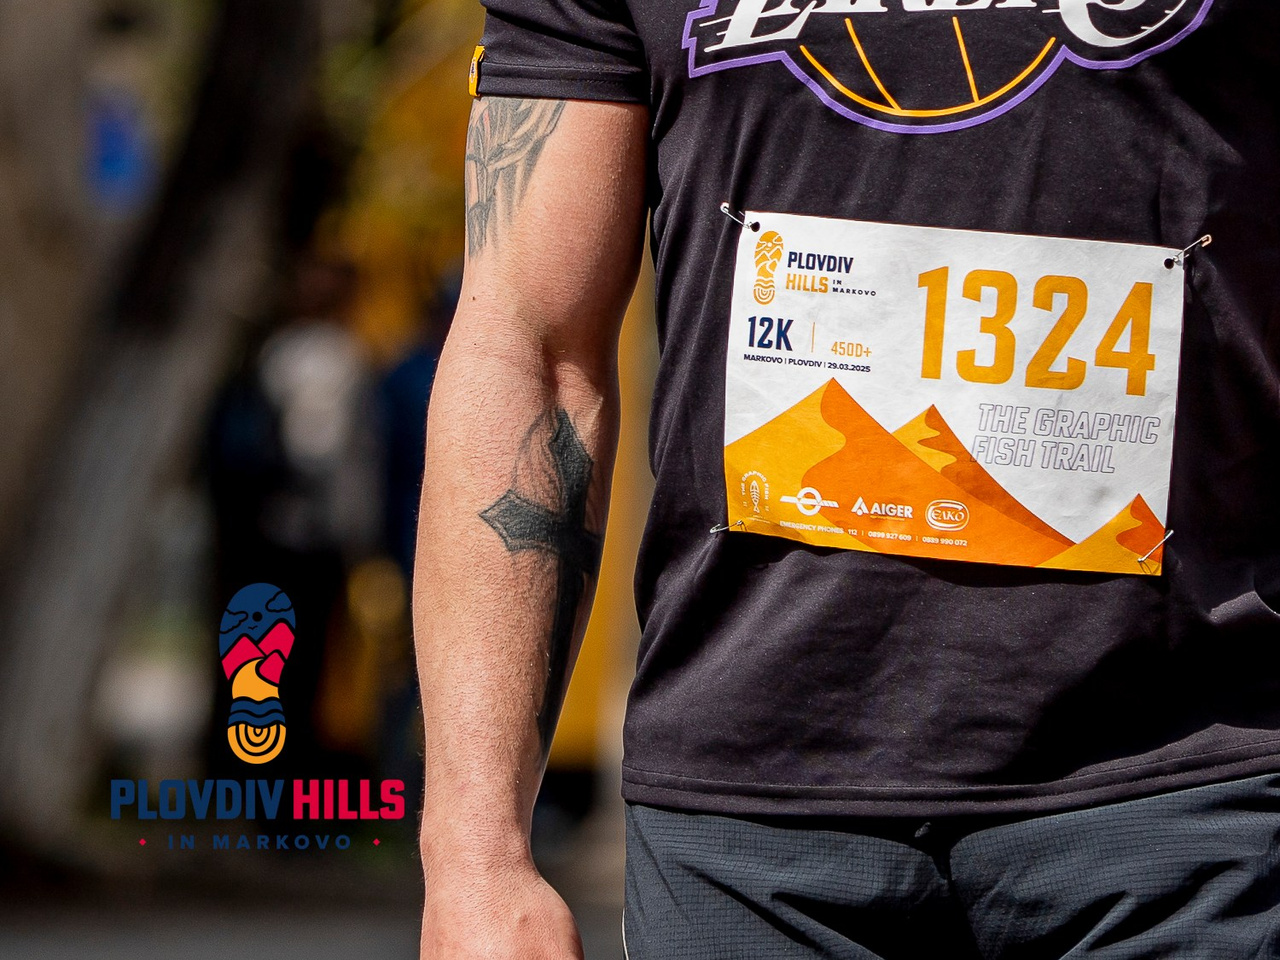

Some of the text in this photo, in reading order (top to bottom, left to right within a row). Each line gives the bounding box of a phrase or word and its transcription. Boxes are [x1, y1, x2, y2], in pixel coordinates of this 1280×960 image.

[787, 251, 854, 273] PLOVDIV
[785, 273, 829, 294] HILLS
[832, 287, 876, 296] MARKOVO
[747, 316, 873, 358] 12K 450D+
[918, 266, 1156, 396] 1324
[743, 353, 871, 373] MARKOVO PLOVDIV 29.03.2025
[978, 403, 1161, 445] THE GRAPHIC
[969, 435, 1115, 474] FISH TRAIL
[870, 502, 913, 519] AIGER
[779, 520, 816, 531] EMERGENCY
[817, 525, 845, 534] PHONES
